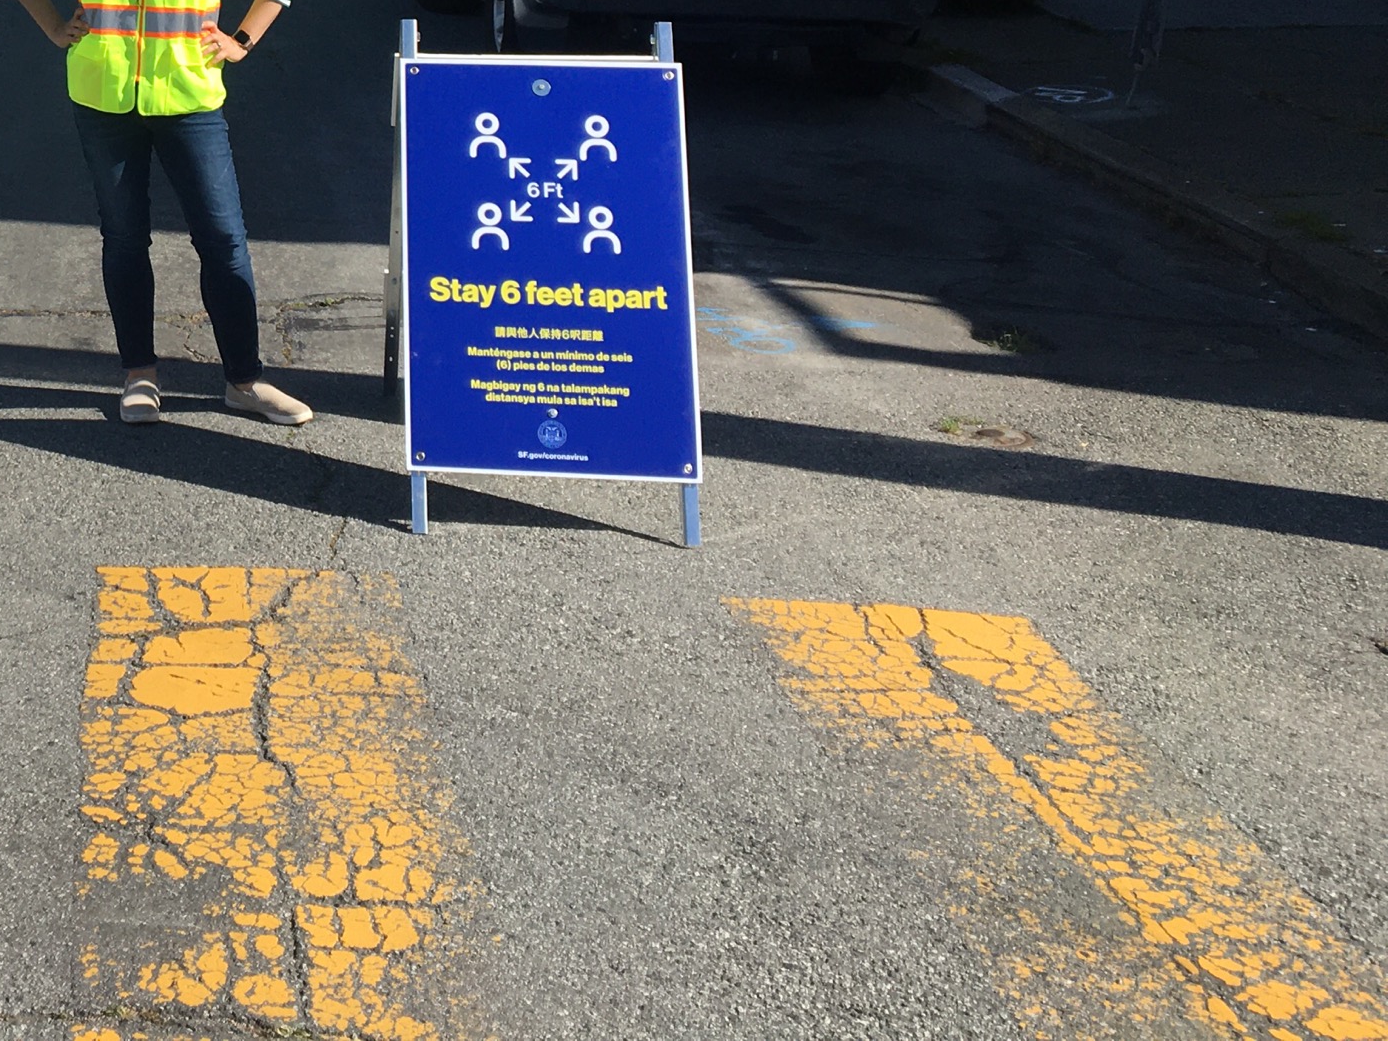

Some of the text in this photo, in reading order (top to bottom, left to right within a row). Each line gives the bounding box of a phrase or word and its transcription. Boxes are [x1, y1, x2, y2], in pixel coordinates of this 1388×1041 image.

[526, 182, 564, 199] 6 Ft
[429, 276, 668, 313] Stay 6 feet apart
[467, 346, 634, 363] Manténgase a un mínimo de seis
[496, 359, 512, 371] (6)
[513, 361, 535, 372] pies
[536, 361, 550, 371] de
[552, 362, 567, 372] los
[470, 379, 630, 397] Magbigay ng 6 na talampakang
[485, 393, 618, 407] distansya mula sa isa't isa
[518, 451, 588, 461] SF.gov/coronavirus
